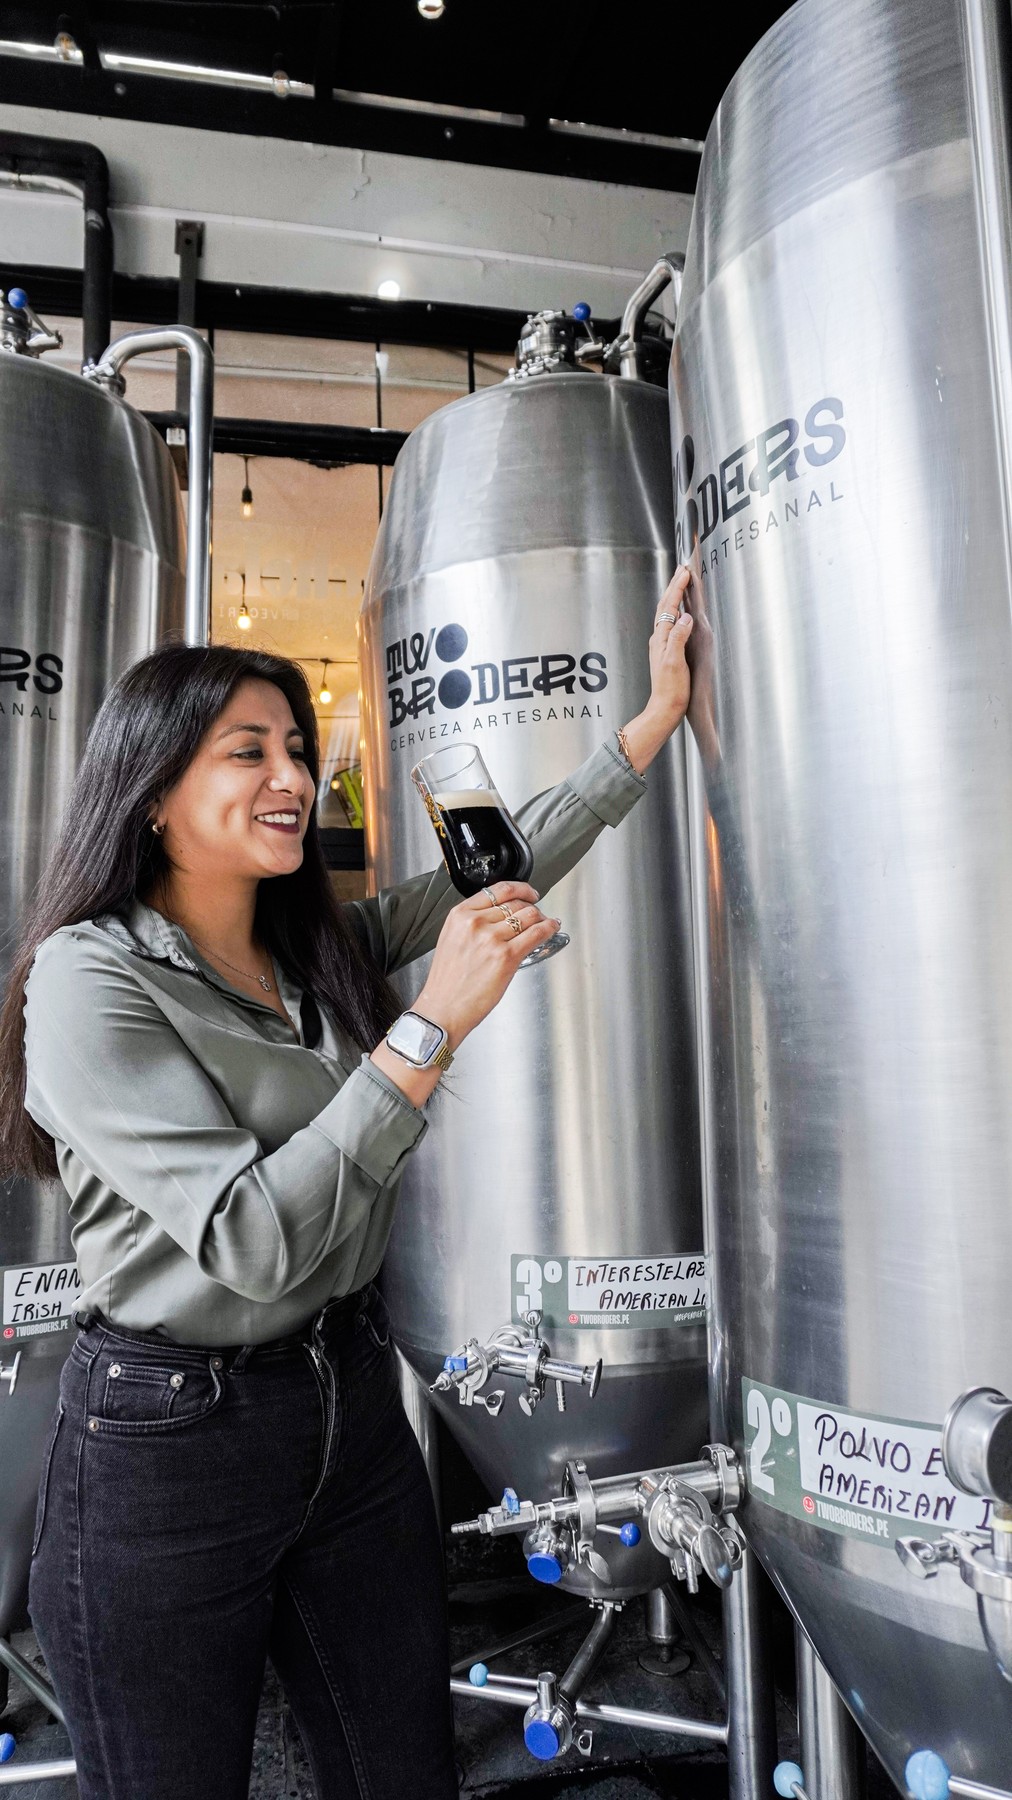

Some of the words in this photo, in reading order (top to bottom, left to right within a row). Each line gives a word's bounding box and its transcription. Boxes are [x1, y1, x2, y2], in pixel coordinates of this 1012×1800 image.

[701, 481, 844, 580] ARTESANAL
[386, 623, 469, 685] TWO
[388, 652, 609, 729] BRODERS
[390, 721, 462, 752] CERVEZA
[473, 704, 603, 730] ARTESANAL
[15, 1318, 69, 1338] TWOBRODERS.PE
[580, 1313, 630, 1325] TWOBRODERS.PE
[814, 1413, 911, 1473] POLVO
[815, 1499, 890, 1539] TWOBRODERS.PE
